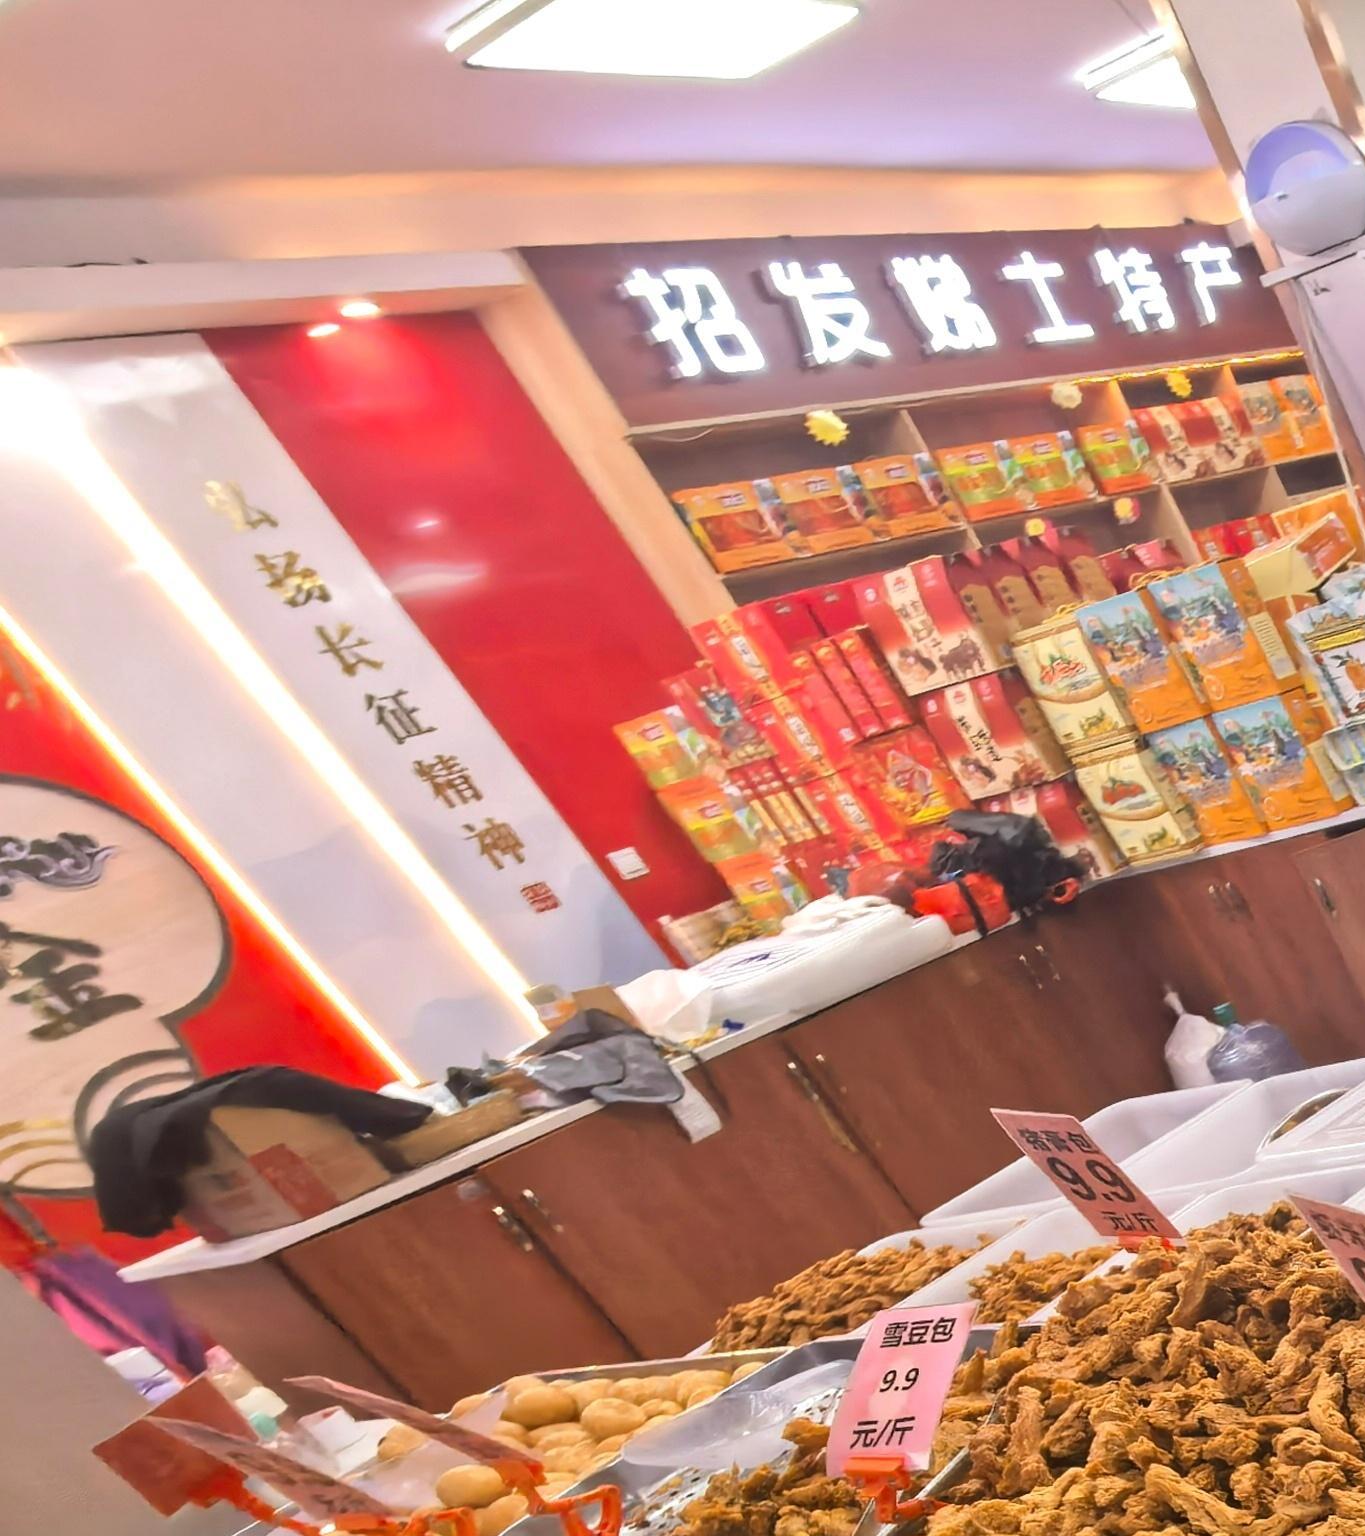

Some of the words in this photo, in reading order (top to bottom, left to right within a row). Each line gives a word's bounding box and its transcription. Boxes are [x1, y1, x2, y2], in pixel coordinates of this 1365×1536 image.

[1046, 1156, 1137, 1202] 9.9
[1100, 1211, 1160, 1233] 元/斤
[880, 1316, 957, 1348] 雪豆包
[879, 1367, 920, 1393] 9.9
[850, 1416, 916, 1450] 元/斤
